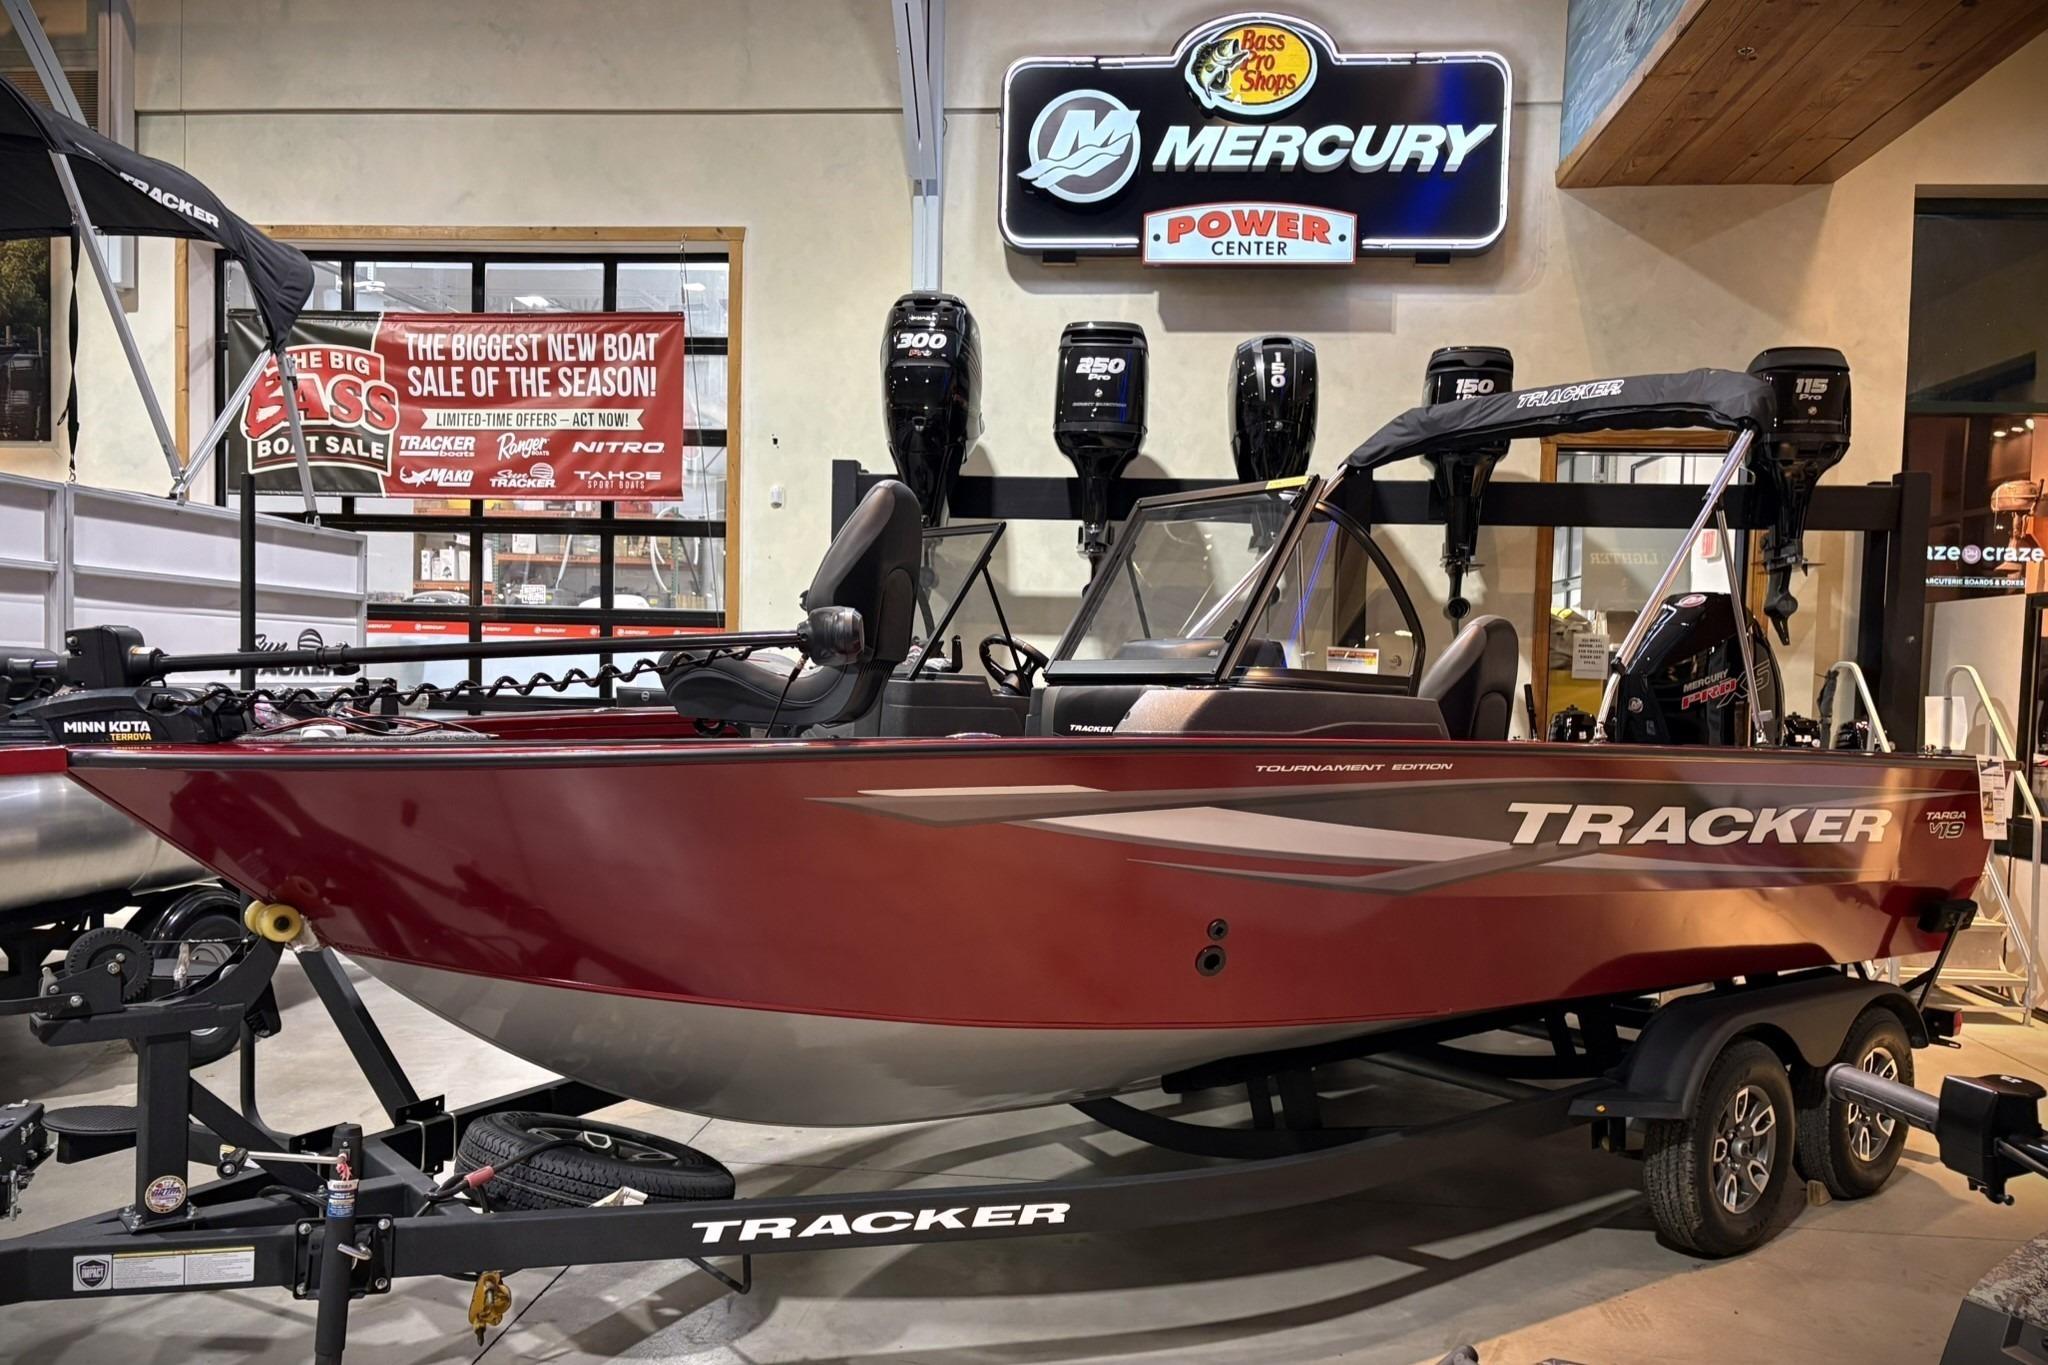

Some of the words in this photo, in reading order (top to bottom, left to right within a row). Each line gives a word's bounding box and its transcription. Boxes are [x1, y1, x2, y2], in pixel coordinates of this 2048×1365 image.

[1240, 29, 1286, 51] Bass
[1240, 50, 1275, 71] Pro
[1240, 70, 1297, 96] Shops
[1152, 123, 1497, 173] MERCURY
[1166, 209, 1332, 245] POWER
[1211, 241, 1288, 256] CENTER
[405, 333, 445, 361] THE
[451, 333, 542, 361] BIGGEST
[547, 333, 597, 362] NEW
[603, 333, 659, 362] BOAT
[896, 332, 947, 349] 300
[908, 348, 932, 357] Pro
[286, 350, 322, 369] HE
[329, 352, 370, 375] BIG
[1075, 356, 1126, 374] 250
[1270, 351, 1286, 388] 150
[408, 367, 465, 398] SALE
[471, 367, 500, 398] OF
[506, 367, 551, 398] THE
[558, 367, 657, 398] SEASON!
[1087, 373, 1112, 381] Pro
[1455, 378, 1495, 394] 150
[1516, 379, 1625, 409] TRACKER
[1795, 378, 1829, 394] 115
[1799, 393, 1822, 401] Pro
[436, 413, 513, 427] LIMITED-TIME
[516, 413, 557, 427] OFFERS
[572, 412, 595, 427] ACT
[598, 412, 629, 427] NOW!
[257, 436, 319, 458] BOT
[325, 436, 385, 461] SALE
[400, 435, 476, 450] TRACKER
[496, 432, 549, 461] Ranger
[572, 441, 664, 453] NITRO
[427, 468, 474, 486] MAKO
[489, 477, 555, 489] TRACKER
[496, 469, 529, 480] Sun
[573, 470, 662, 481] TAHOE
[587, 481, 614, 489] SPORT
[619, 481, 645, 489] BOATS
[1982, 546, 2045, 562] craze
[1682, 668, 1729, 692] MERCURY
[1681, 678, 1737, 710] PRO
[64, 721, 105, 733] MINN
[109, 721, 150, 732] KOTA
[1069, 724, 1113, 734] TRACKER
[110, 733, 152, 741] TERROVA
[1256, 763, 1386, 773] TOURNAMENT
[1391, 763, 1453, 771] EDITION
[1507, 801, 1893, 846] TRACKER
[1926, 811, 1967, 820] TARGA
[1929, 821, 1965, 840] V19
[691, 1202, 1071, 1244] TRACKER
